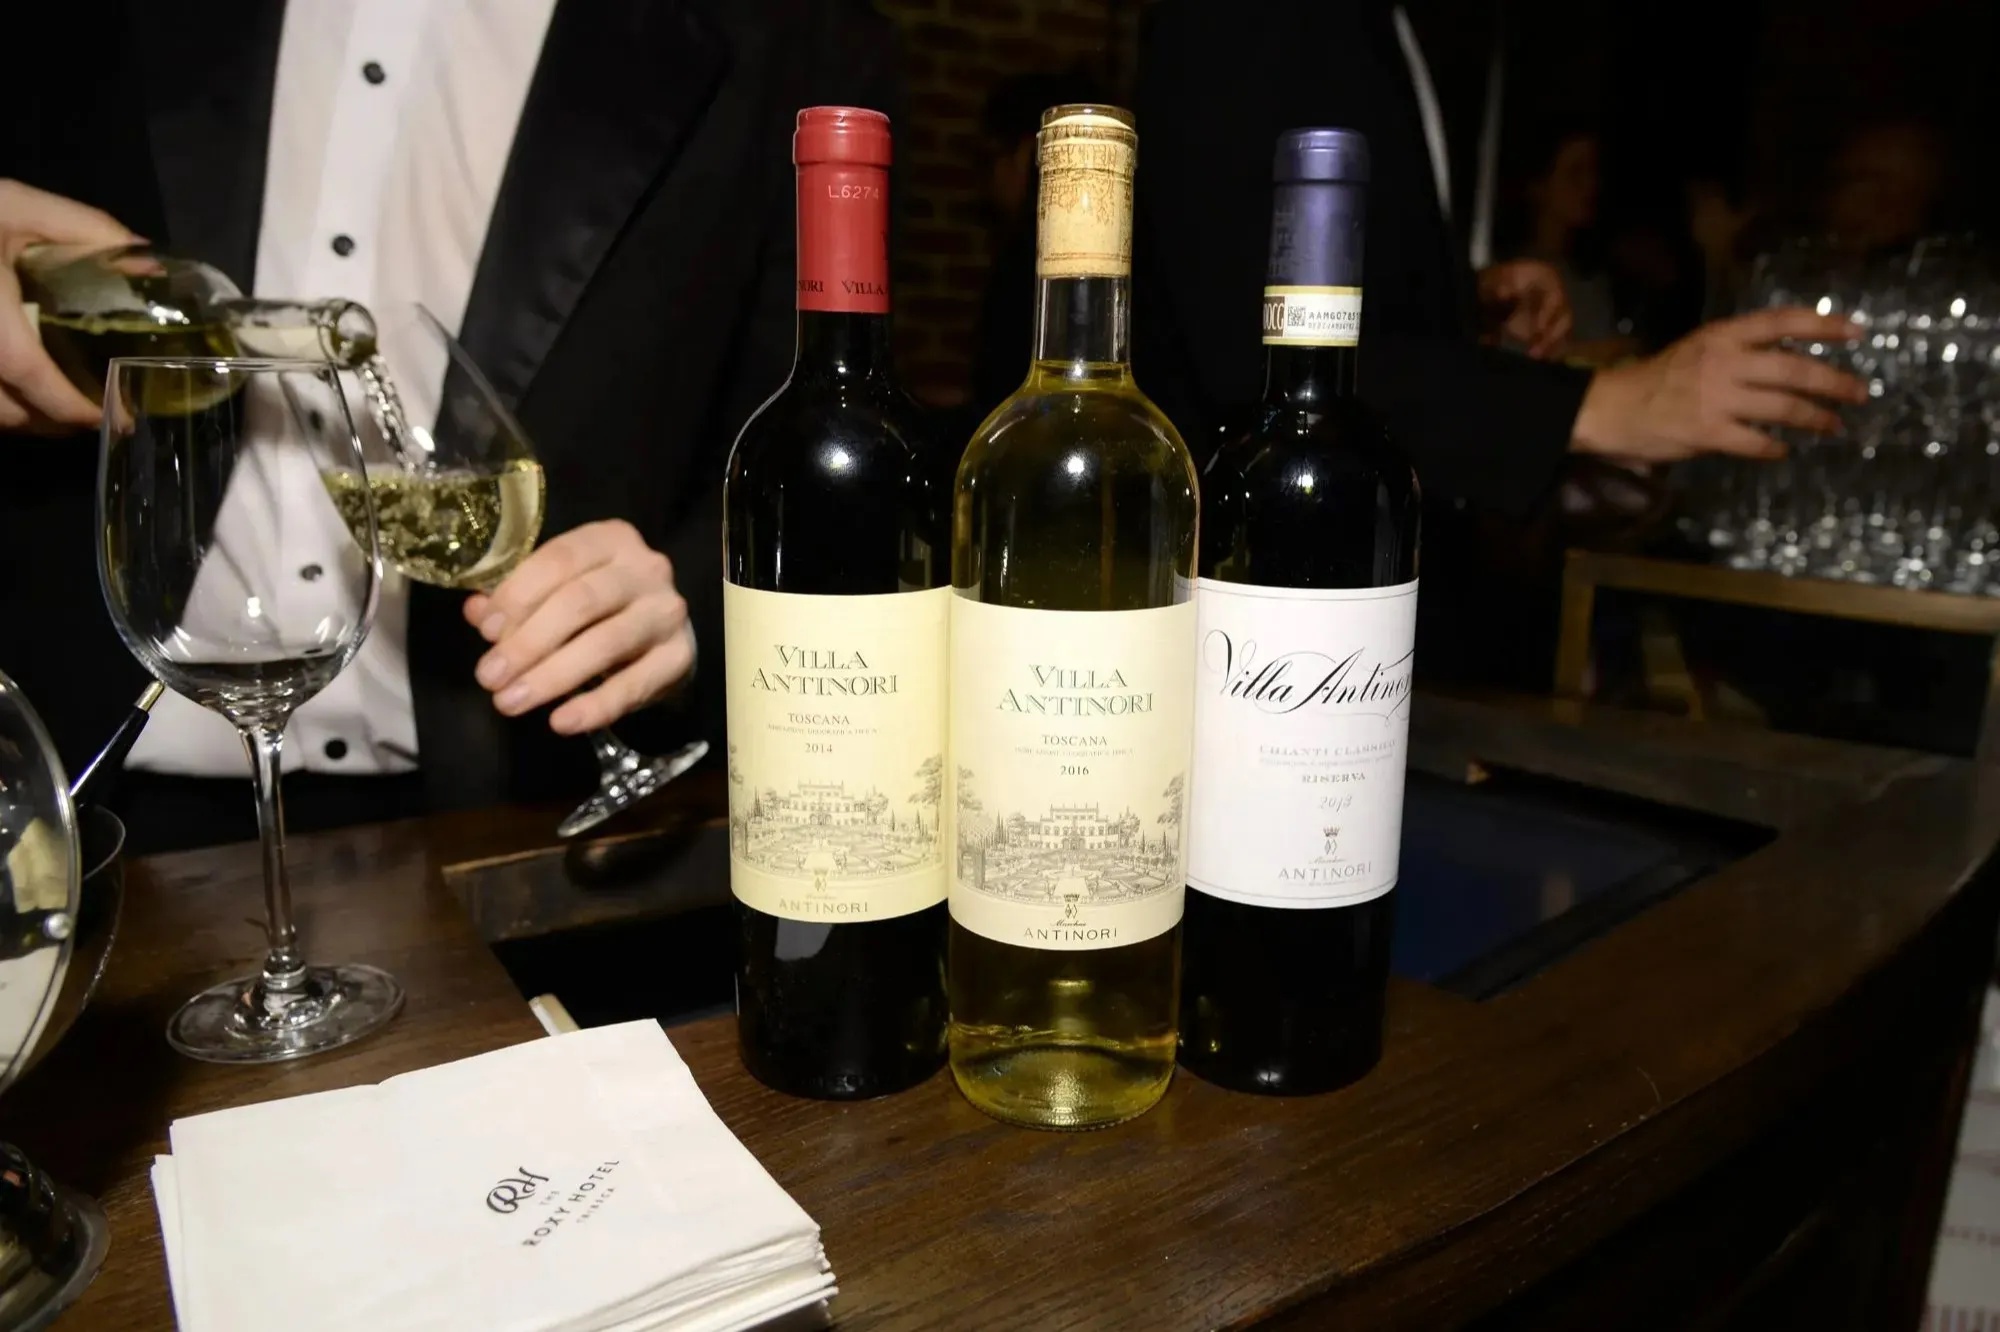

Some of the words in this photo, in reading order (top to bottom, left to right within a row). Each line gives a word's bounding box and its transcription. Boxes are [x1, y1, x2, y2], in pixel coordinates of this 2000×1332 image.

[841, 280, 884, 295] VILLA
[774, 644, 869, 669] VILLA
[1203, 629, 1294, 704] Villa
[750, 667, 899, 696] ANTINORI
[1029, 664, 1128, 689] VILLA
[996, 687, 1154, 716] ANTINORI
[787, 712, 850, 725] TOSCANA
[805, 742, 833, 753] 2014
[1042, 735, 1108, 746] TOSCANA
[1060, 765, 1090, 776] 2016
[1302, 772, 1366, 783] RISERVA
[1278, 861, 1372, 880] ANTINORI
[779, 898, 868, 914] ANTINORI
[1024, 927, 1117, 941] ANTINORI
[522, 1206, 570, 1246] ROXY
[568, 1160, 620, 1202] HOTEL
